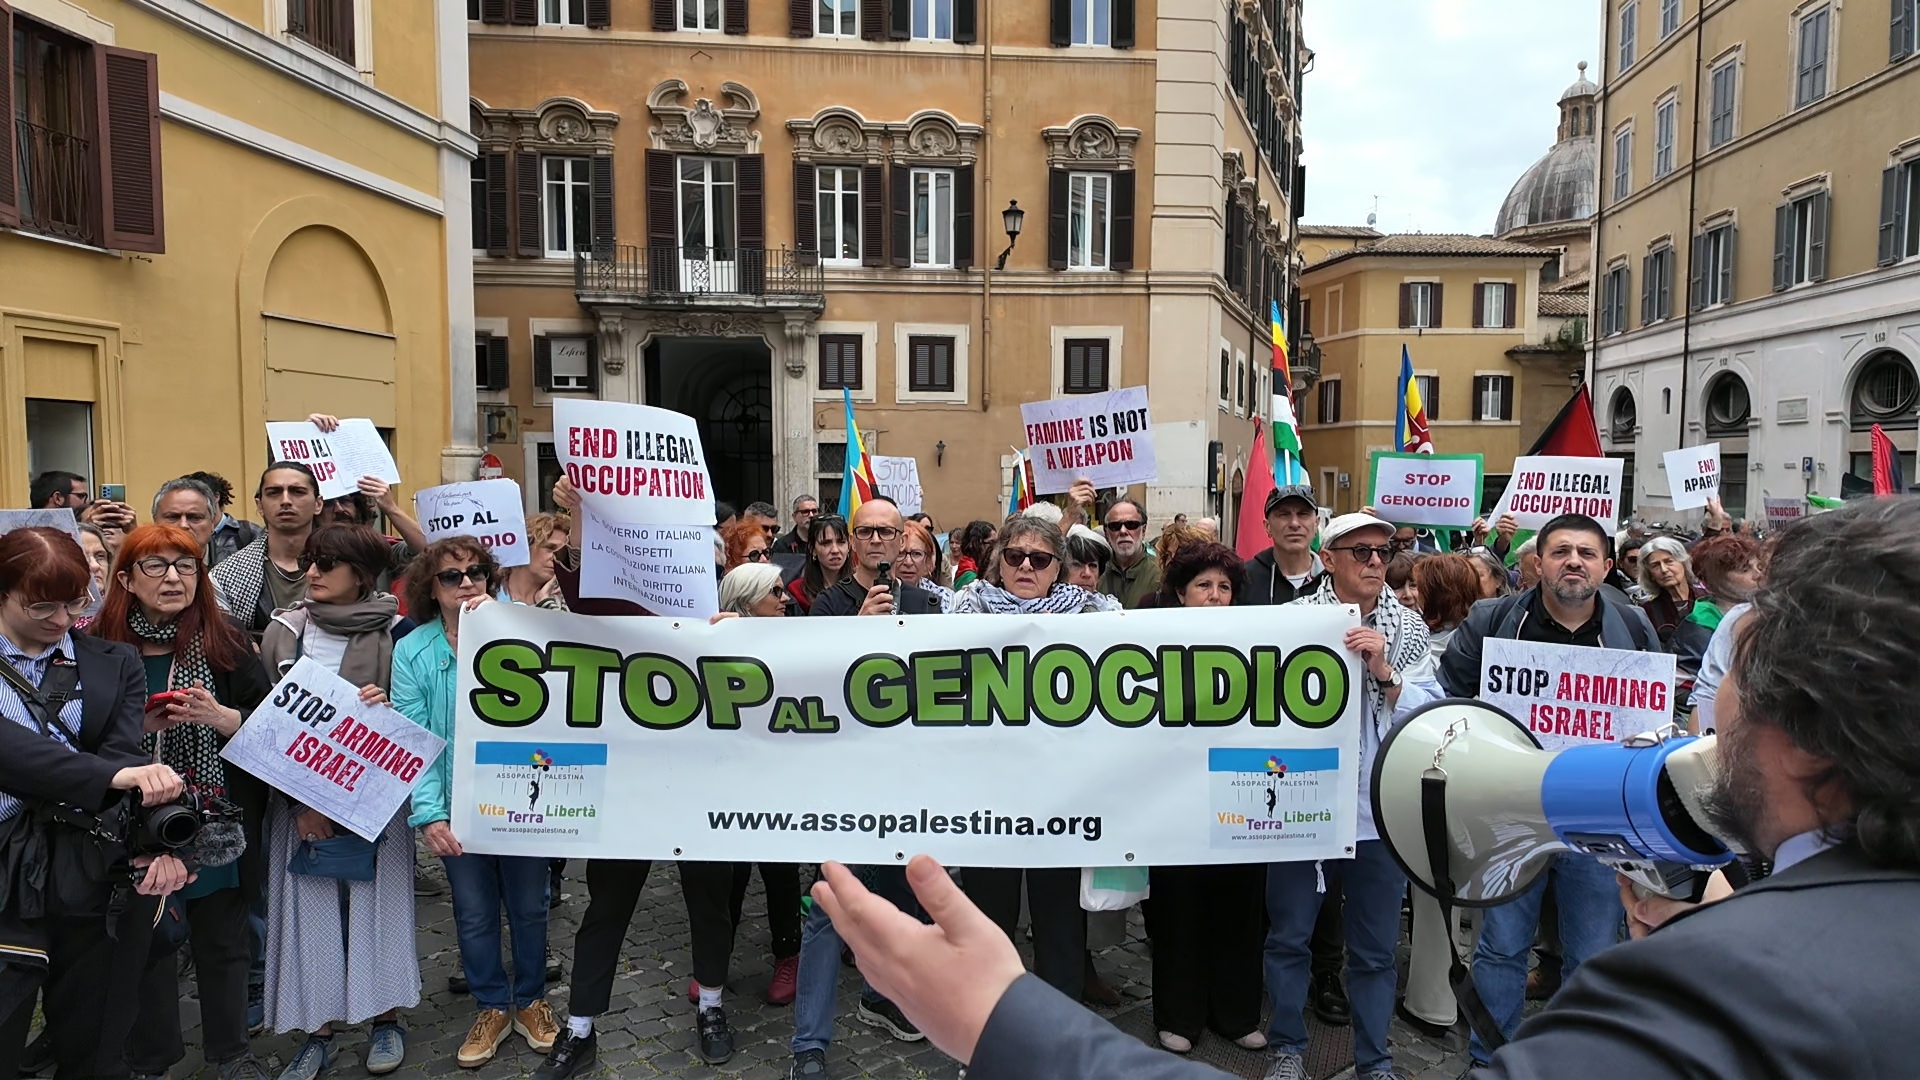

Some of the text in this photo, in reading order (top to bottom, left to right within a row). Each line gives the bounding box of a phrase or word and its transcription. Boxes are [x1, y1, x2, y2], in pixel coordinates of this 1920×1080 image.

[1026, 408, 1147, 446] FAMINE IS NOT
[280, 440, 310, 460] END
[569, 427, 699, 466] END ILLEGAL
[1046, 438, 1134, 470] A WEAPON
[876, 459, 915, 482] STOP
[1698, 459, 1715, 473] END
[1804, 458, 1811, 472] P
[566, 462, 705, 500] OCCUPATION
[1405, 473, 1451, 486] STOP
[1517, 472, 1611, 494] END ILLEGAL
[876, 484, 920, 507] ENOCIDE
[1381, 494, 1470, 508] GENOCIDIO
[1510, 494, 1613, 518] OCCUPATION
[428, 511, 499, 532] STOP AL
[656, 530, 702, 541] ITALIANO
[591, 541, 604, 552] LA
[663, 565, 707, 574] ITALIANA
[624, 544, 673, 558] RISPETTI
[613, 575, 695, 609] INTERNAZIONALE
[642, 578, 683, 594] DIRITTO
[470, 639, 1350, 733] STOP AL GENOCIDIO
[1487, 665, 1667, 712] STOP ARMING
[273, 682, 424, 784] STOP ARMING
[1529, 703, 1615, 741] ISRAEL
[284, 731, 366, 792] ISRAEL
[479, 803, 596, 824] Vita Terra Libertà
[707, 809, 1102, 841] www.assopalestina.org
[1217, 809, 1331, 831] Vita Terra Libertà
[491, 826, 579, 835] www.assopacepalestina.org
[1231, 832, 1317, 841] www.assopacepalestina.org
